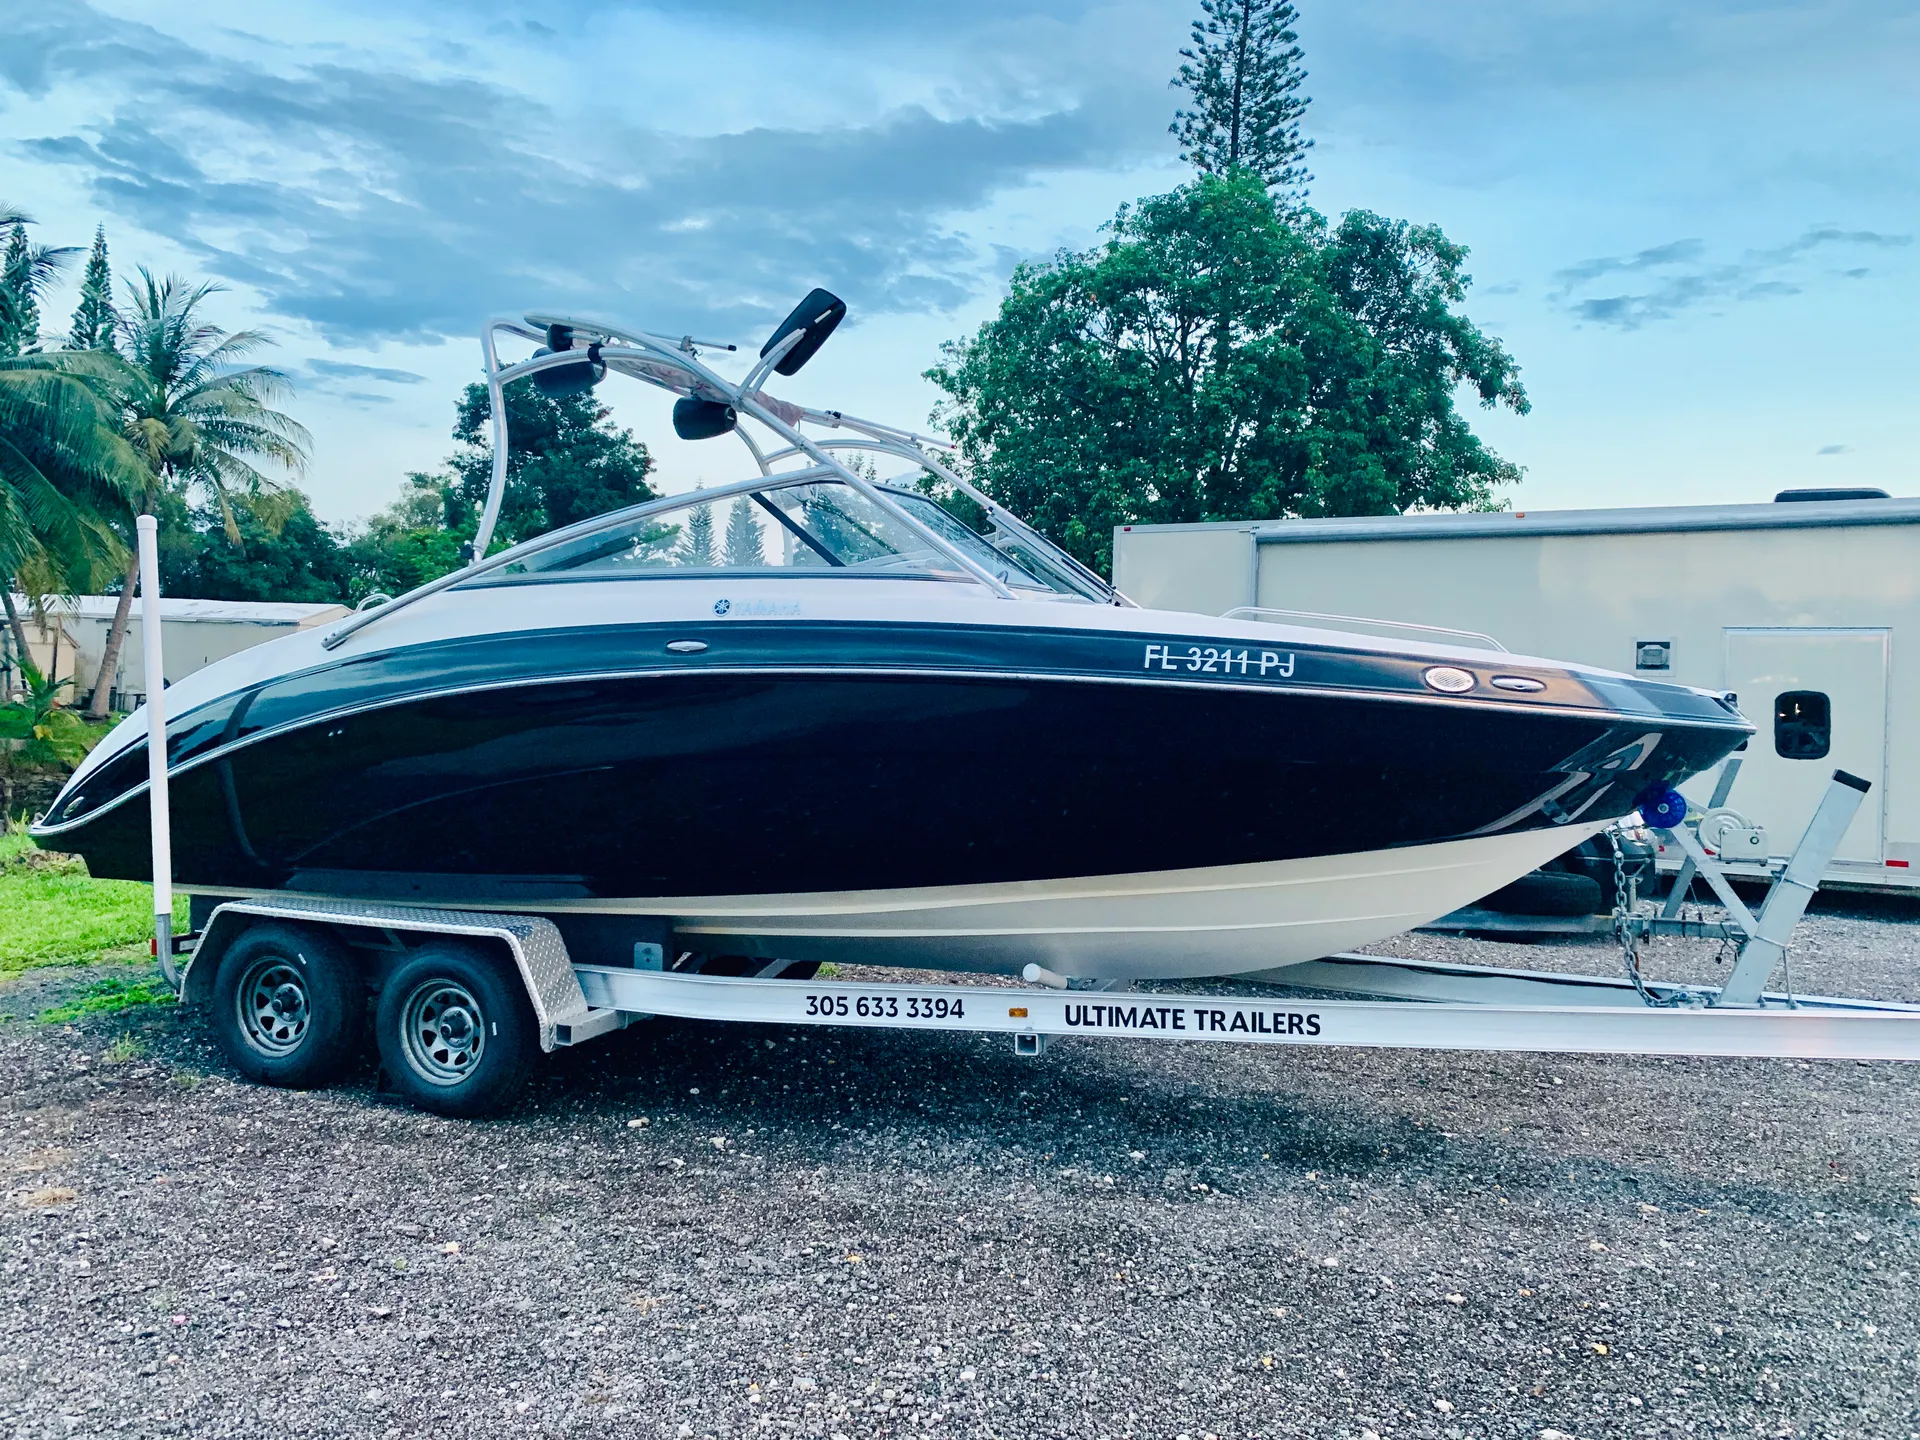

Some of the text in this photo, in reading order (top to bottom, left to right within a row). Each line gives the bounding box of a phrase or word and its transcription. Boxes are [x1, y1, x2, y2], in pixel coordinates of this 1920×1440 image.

[1144, 644, 1295, 678] FL 3211 PJ
[805, 995, 965, 1019] 305 633 3394
[1064, 1004, 1321, 1036] ULTIMATE TRAILERS
